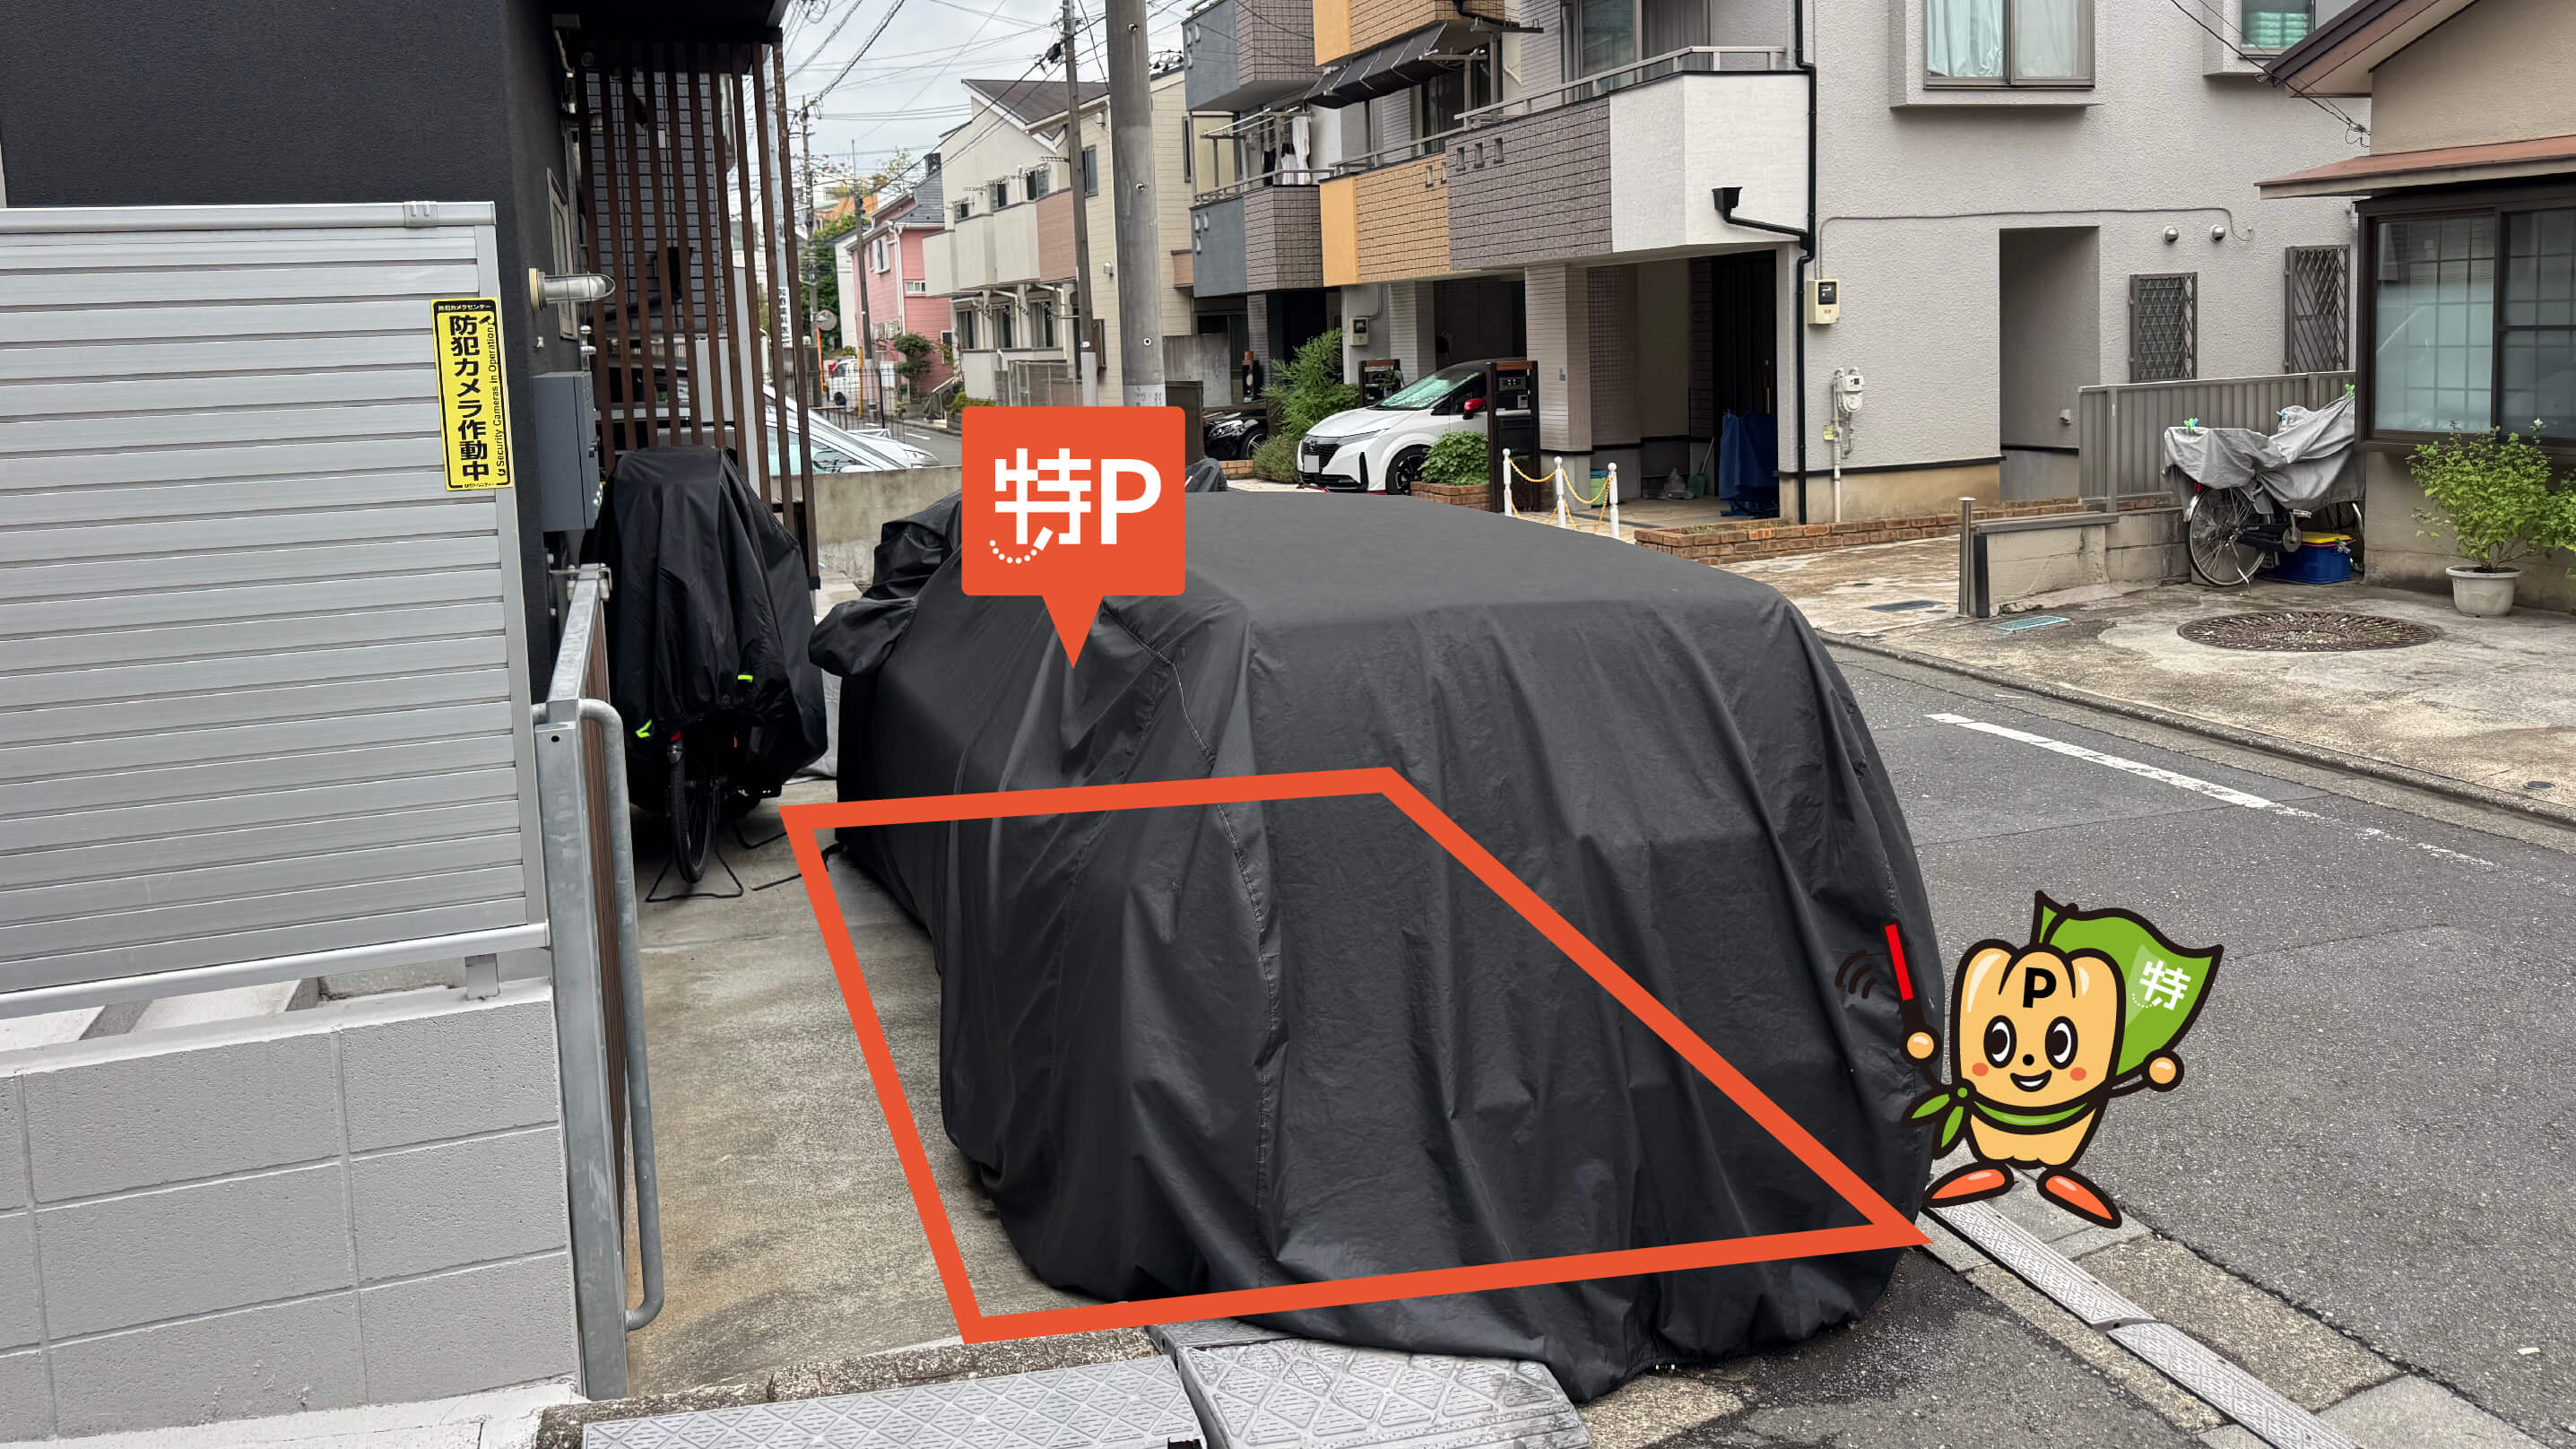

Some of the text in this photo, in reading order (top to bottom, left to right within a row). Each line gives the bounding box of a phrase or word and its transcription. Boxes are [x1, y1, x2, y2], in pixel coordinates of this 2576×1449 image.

[449, 315, 490, 482] 防犯カメラ作動中
[488, 327, 505, 467] Security Cameras in Operation
